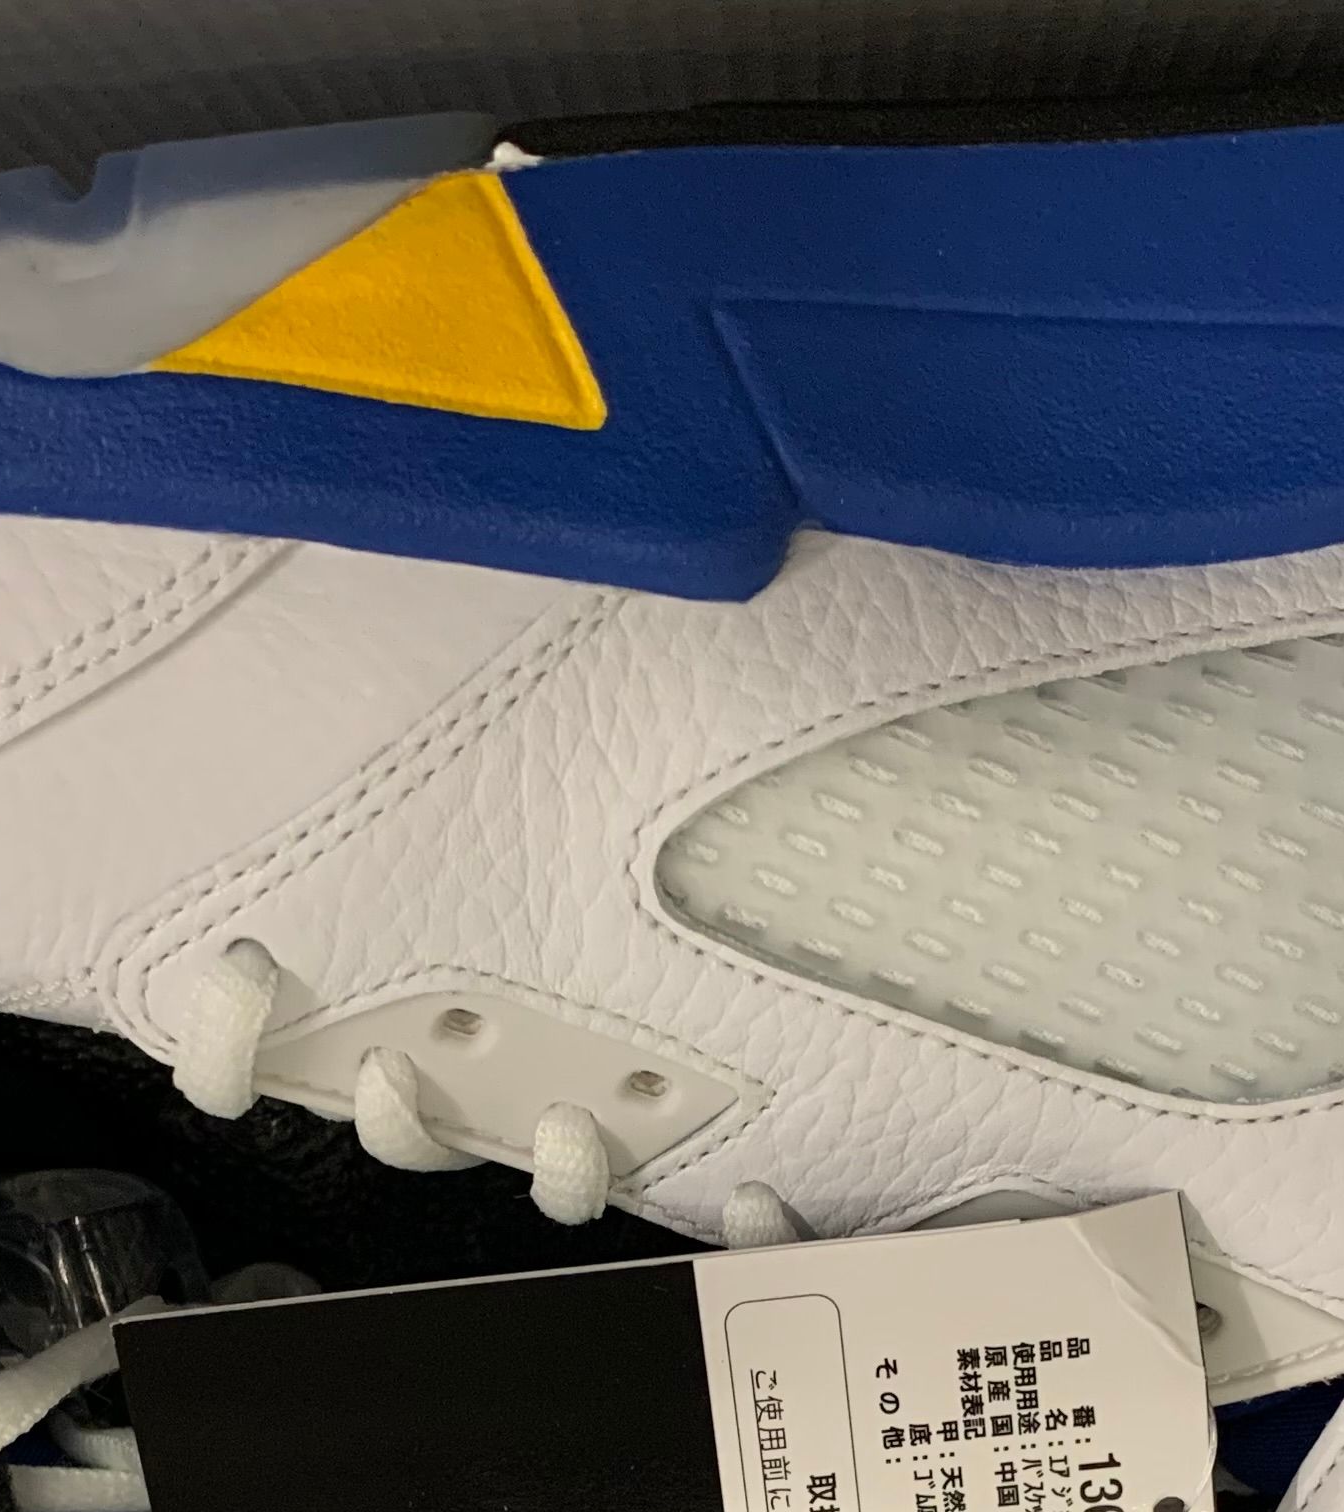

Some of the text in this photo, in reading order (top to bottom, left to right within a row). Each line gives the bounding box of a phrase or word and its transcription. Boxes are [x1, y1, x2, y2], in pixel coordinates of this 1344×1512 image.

[957, 1347, 986, 1440] 素材表記
[994, 1461, 1020, 1507] 中国
